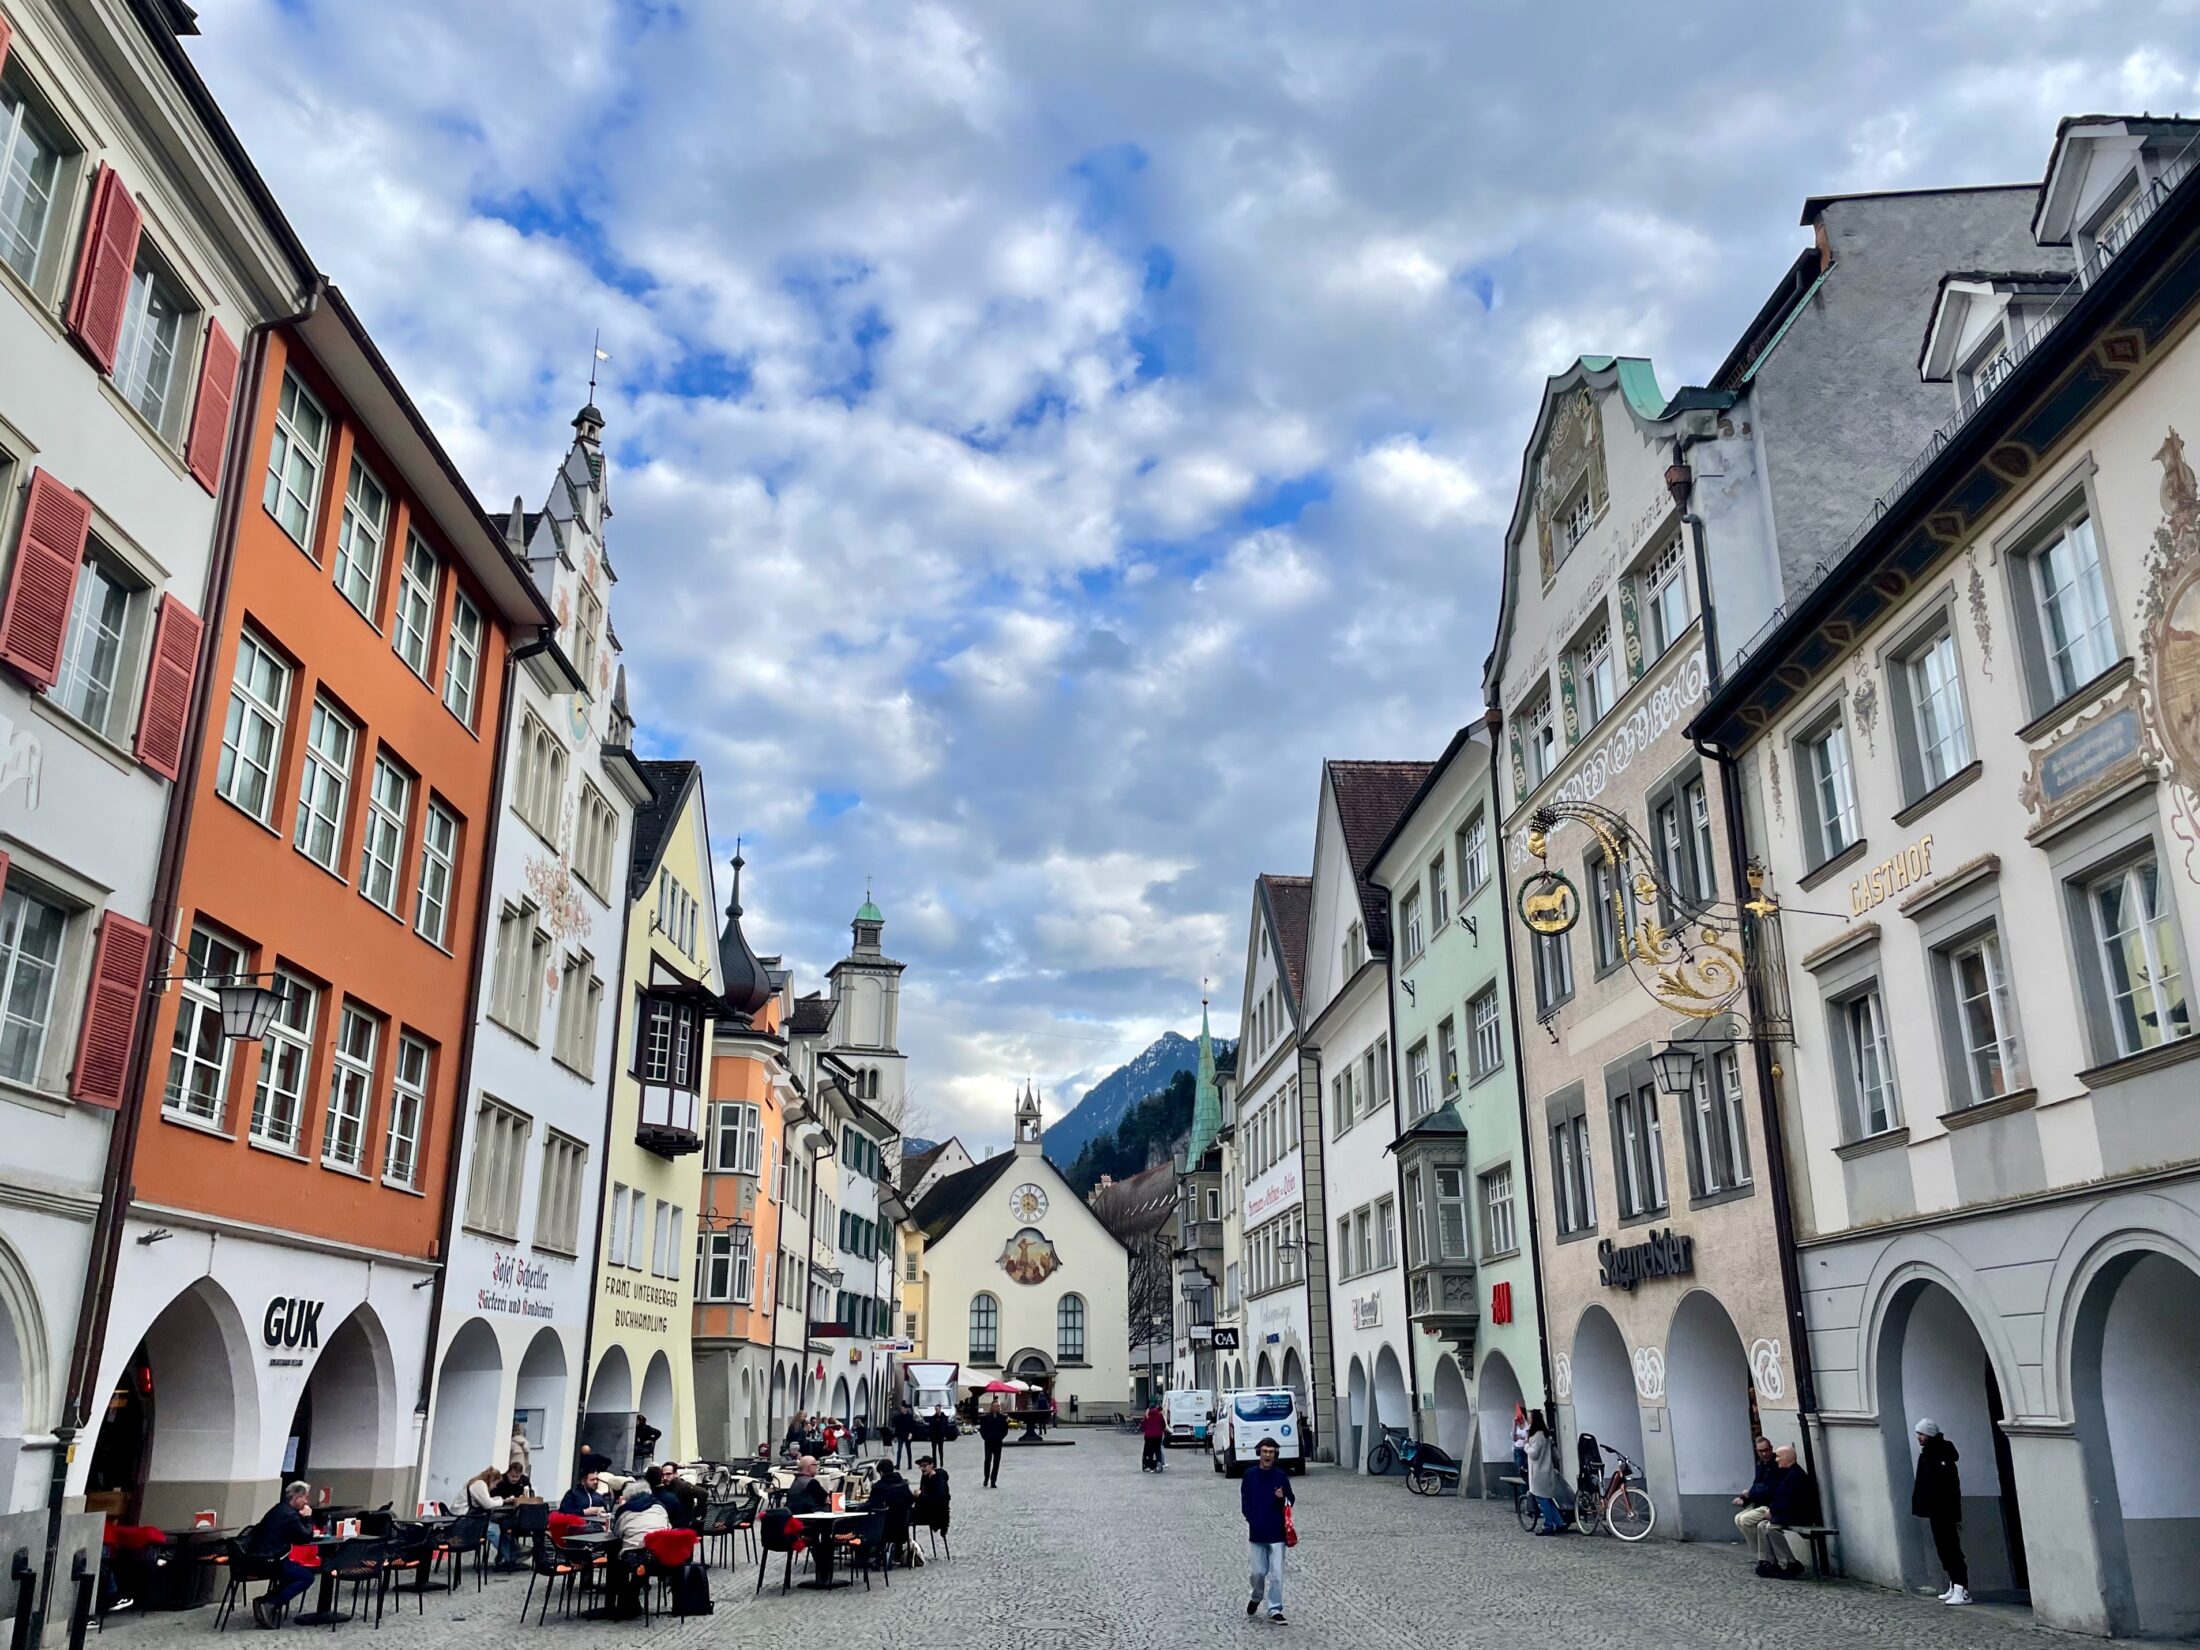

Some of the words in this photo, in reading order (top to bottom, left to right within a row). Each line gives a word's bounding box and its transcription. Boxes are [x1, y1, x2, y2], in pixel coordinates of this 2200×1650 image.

[1849, 833, 1934, 917] GASTHOF
[1598, 1228, 1692, 1291] Sagmeister
[509, 1297, 520, 1314] und
[522, 1298, 554, 1319] Konditorei
[605, 1276, 631, 1298] FRANZ
[634, 1283, 678, 1307] UNTERBERGER
[264, 1296, 325, 1348] GUK
[615, 1309, 668, 1333] BUCHHANDLUNG
